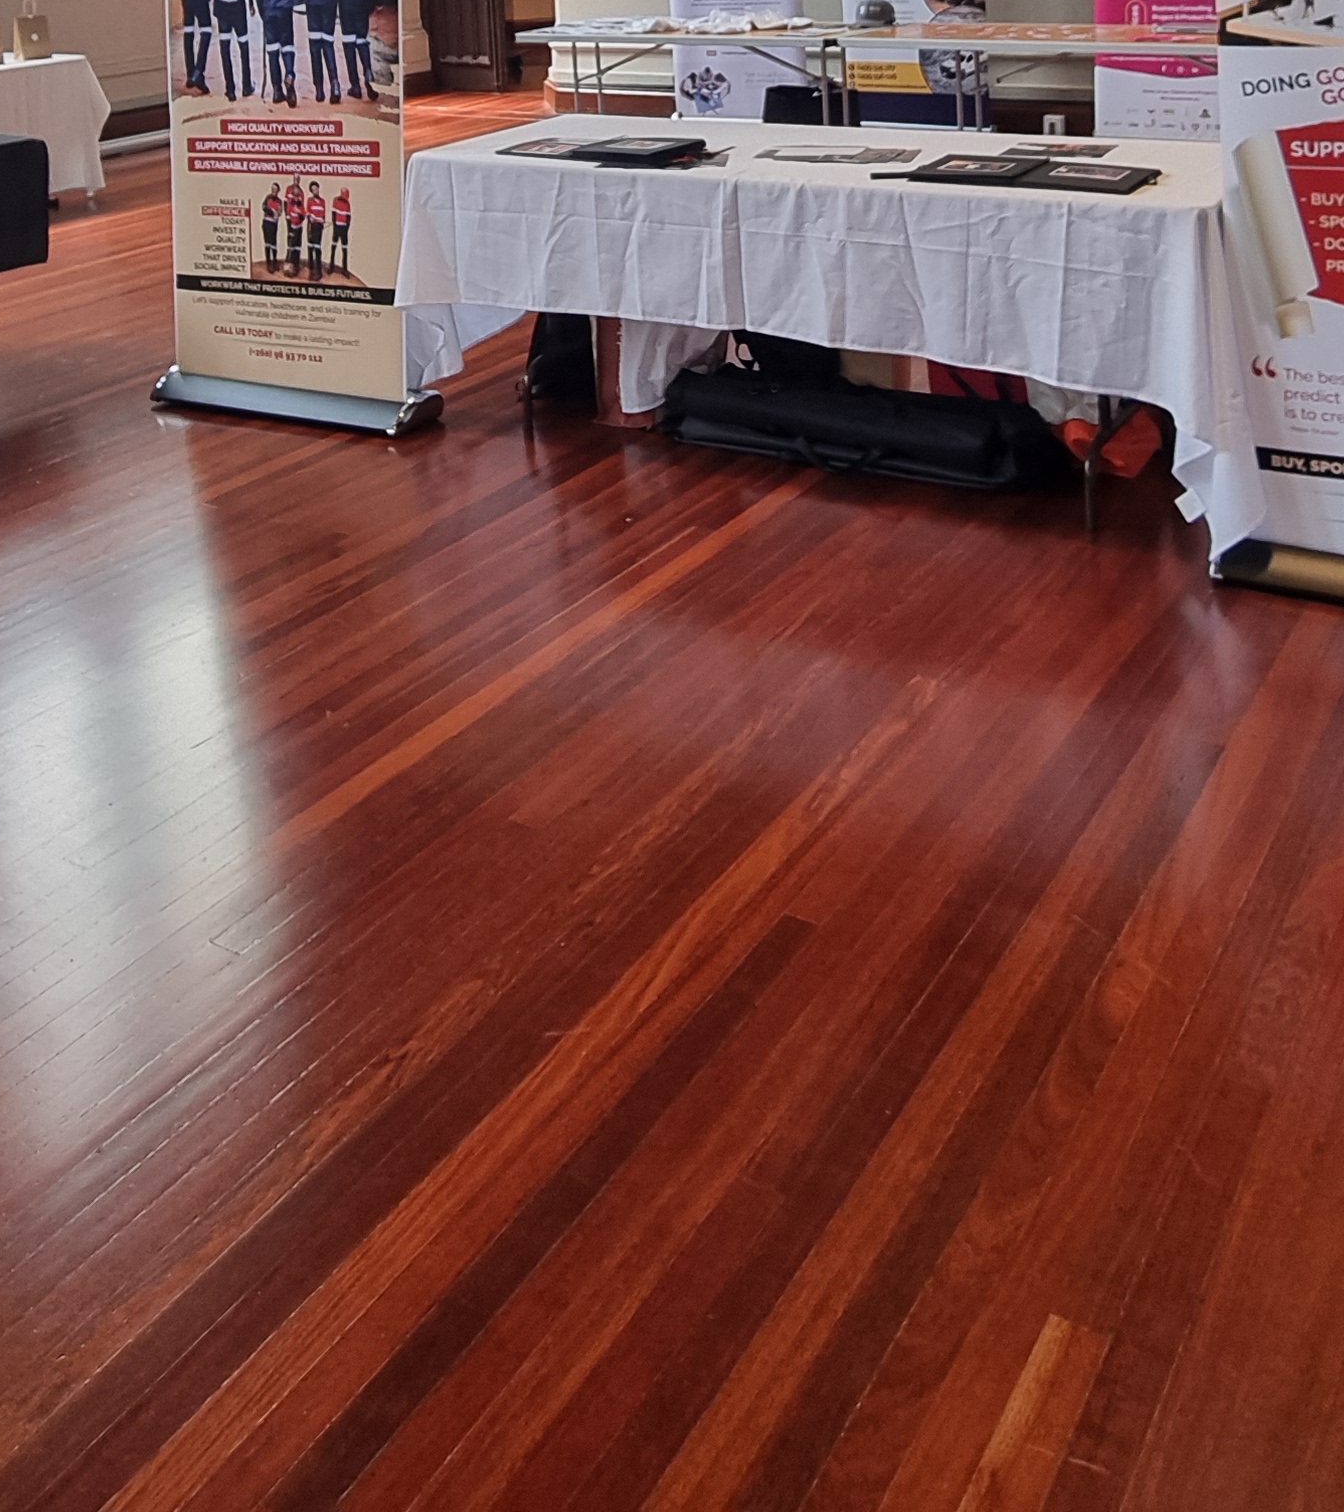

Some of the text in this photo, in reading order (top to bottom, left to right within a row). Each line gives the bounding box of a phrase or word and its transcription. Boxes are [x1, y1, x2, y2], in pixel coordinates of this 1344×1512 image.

[1240, 72, 1311, 97] DOING
[227, 122, 336, 134] HIGH QUALITY WORKWEAR
[195, 140, 370, 155] SUPPORT EDUCATION AND SKILLS TRAINING
[194, 159, 373, 174] SUSTAINABLE GIVING THROUGH ENTERPRISE
[214, 325, 273, 338] CALL US TODAY
[1283, 367, 1313, 384] The
[1283, 388, 1341, 405] predict
[1300, 407, 1317, 422] to
[1271, 453, 1308, 474] BUY,
